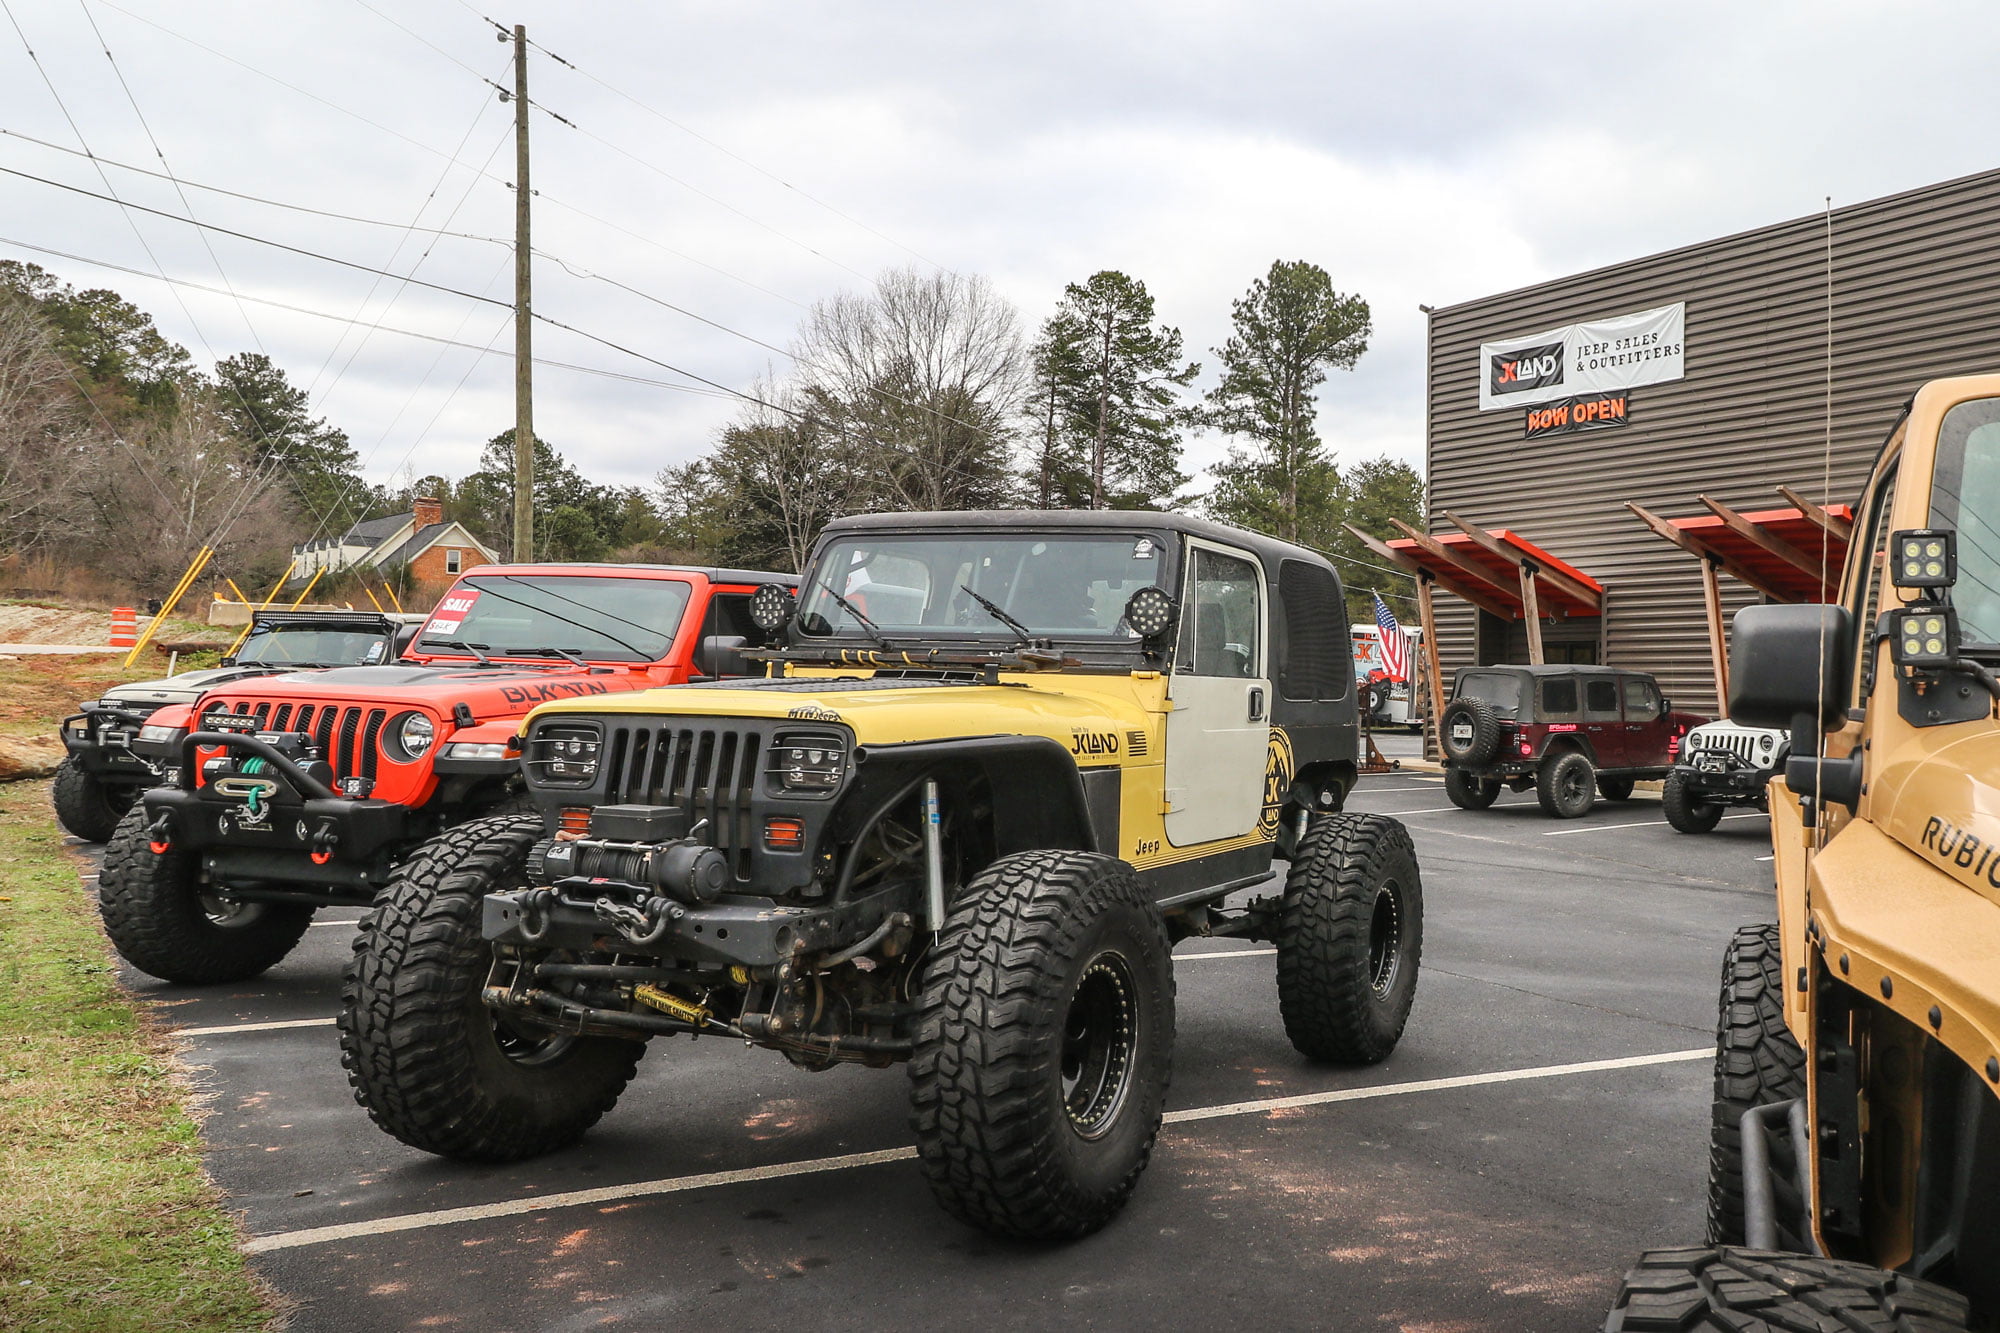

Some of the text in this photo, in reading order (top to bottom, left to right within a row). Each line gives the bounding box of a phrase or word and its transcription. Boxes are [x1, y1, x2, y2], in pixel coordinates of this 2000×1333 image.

[1576, 343, 1681, 372] & OUTFITTERS
[1577, 332, 1659, 360] JEEP SALES
[1498, 355, 1557, 384] JKLAND
[1528, 398, 1625, 431] NOW OPEN
[441, 597, 475, 612] SALE
[1071, 733, 1119, 755] JKLAND
[1265, 776, 1280, 803] JK
[1135, 839, 1160, 856] Jeep
